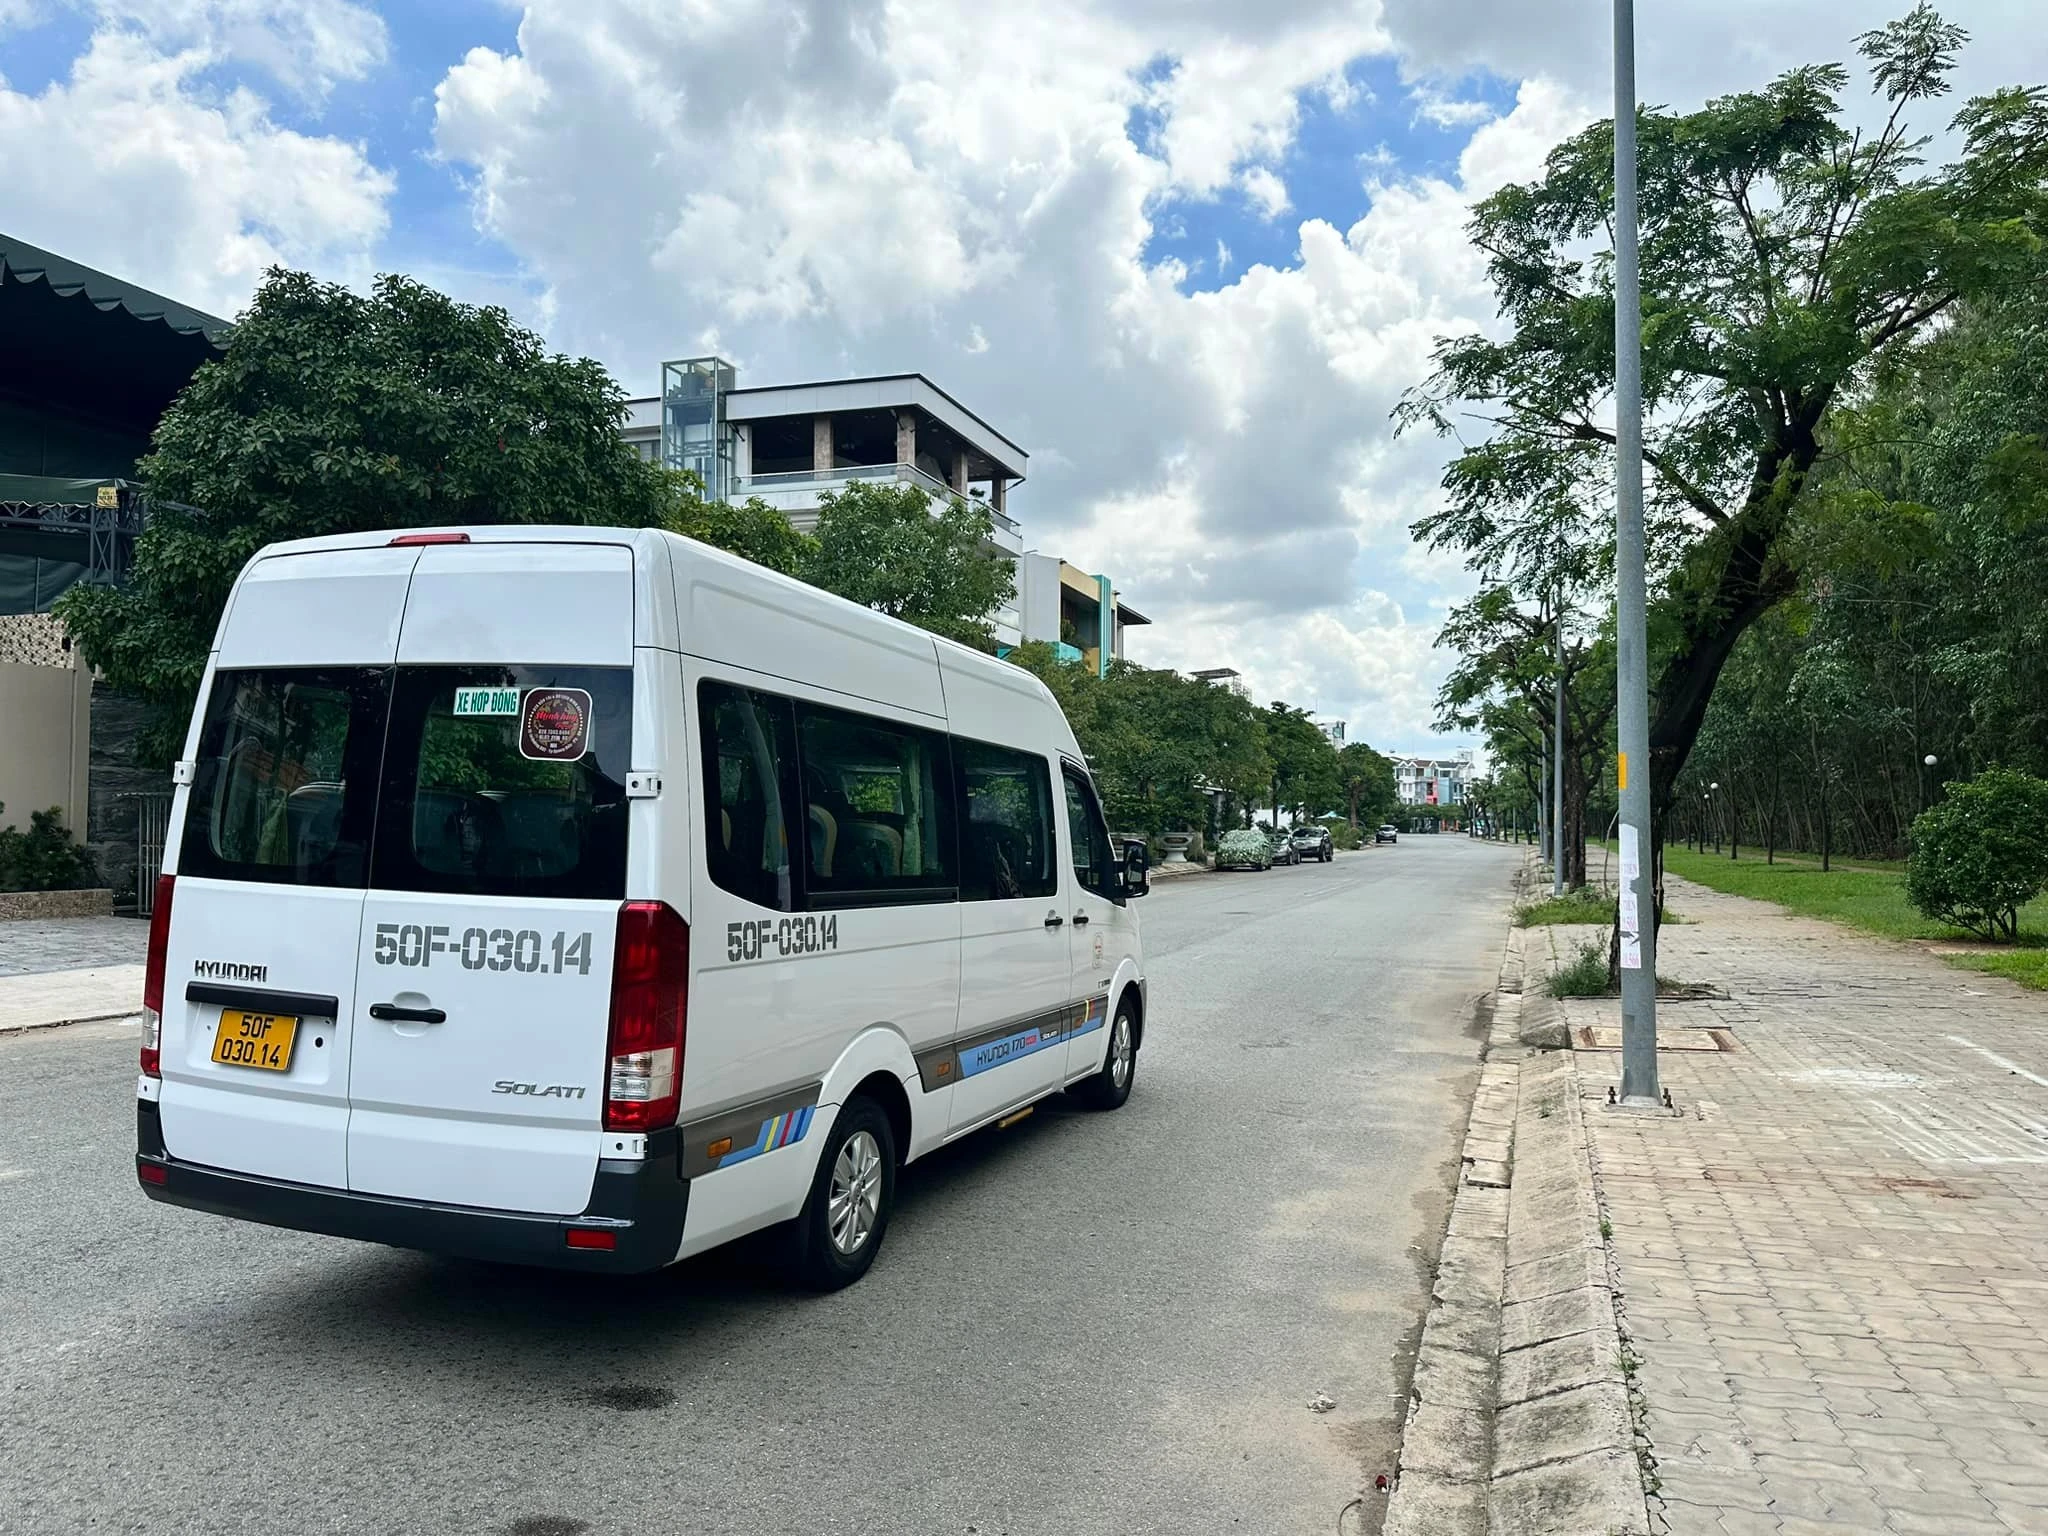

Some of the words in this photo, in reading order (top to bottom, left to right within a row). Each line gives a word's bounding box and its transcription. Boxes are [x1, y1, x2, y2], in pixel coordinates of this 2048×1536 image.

[457, 691, 470, 713] XE
[375, 923, 592, 976] 50F-030.14
[728, 914, 838, 962] 50F-030.14
[195, 959, 268, 982] HYUNDAI
[240, 1014, 275, 1039] 50F
[220, 1038, 281, 1067] 030.14
[976, 1042, 1009, 1067] HYUNDAI
[491, 1080, 586, 1099] SOLATI
